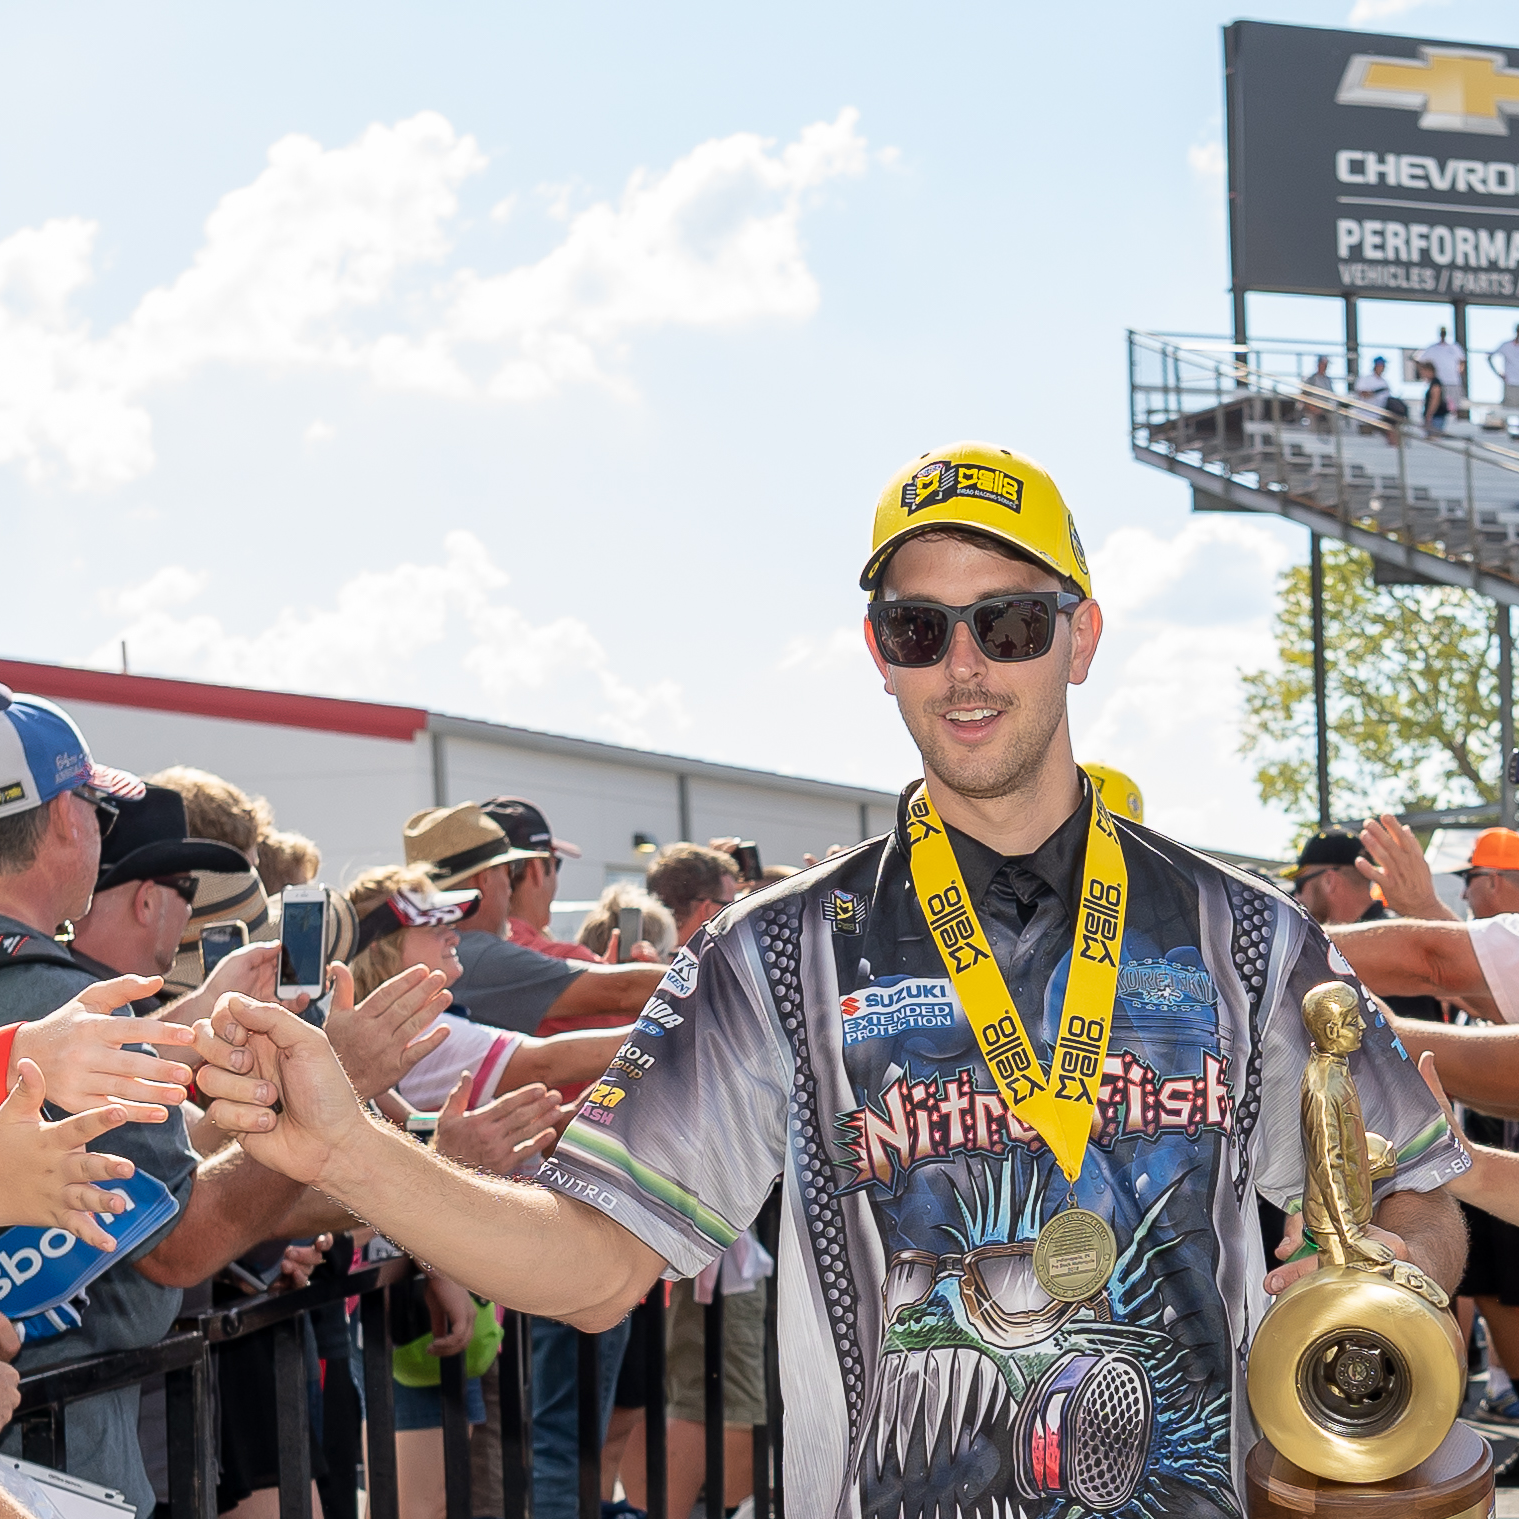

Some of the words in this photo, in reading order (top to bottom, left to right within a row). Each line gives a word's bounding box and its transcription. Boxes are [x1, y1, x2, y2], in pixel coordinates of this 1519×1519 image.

[1338, 262, 1437, 293] VEHICLES
[1452, 269, 1514, 297] PARTS
[865, 984, 947, 1009] SUZUKI
[843, 1004, 950, 1034] EXTENDED
[845, 1015, 952, 1045] PROTECTION
